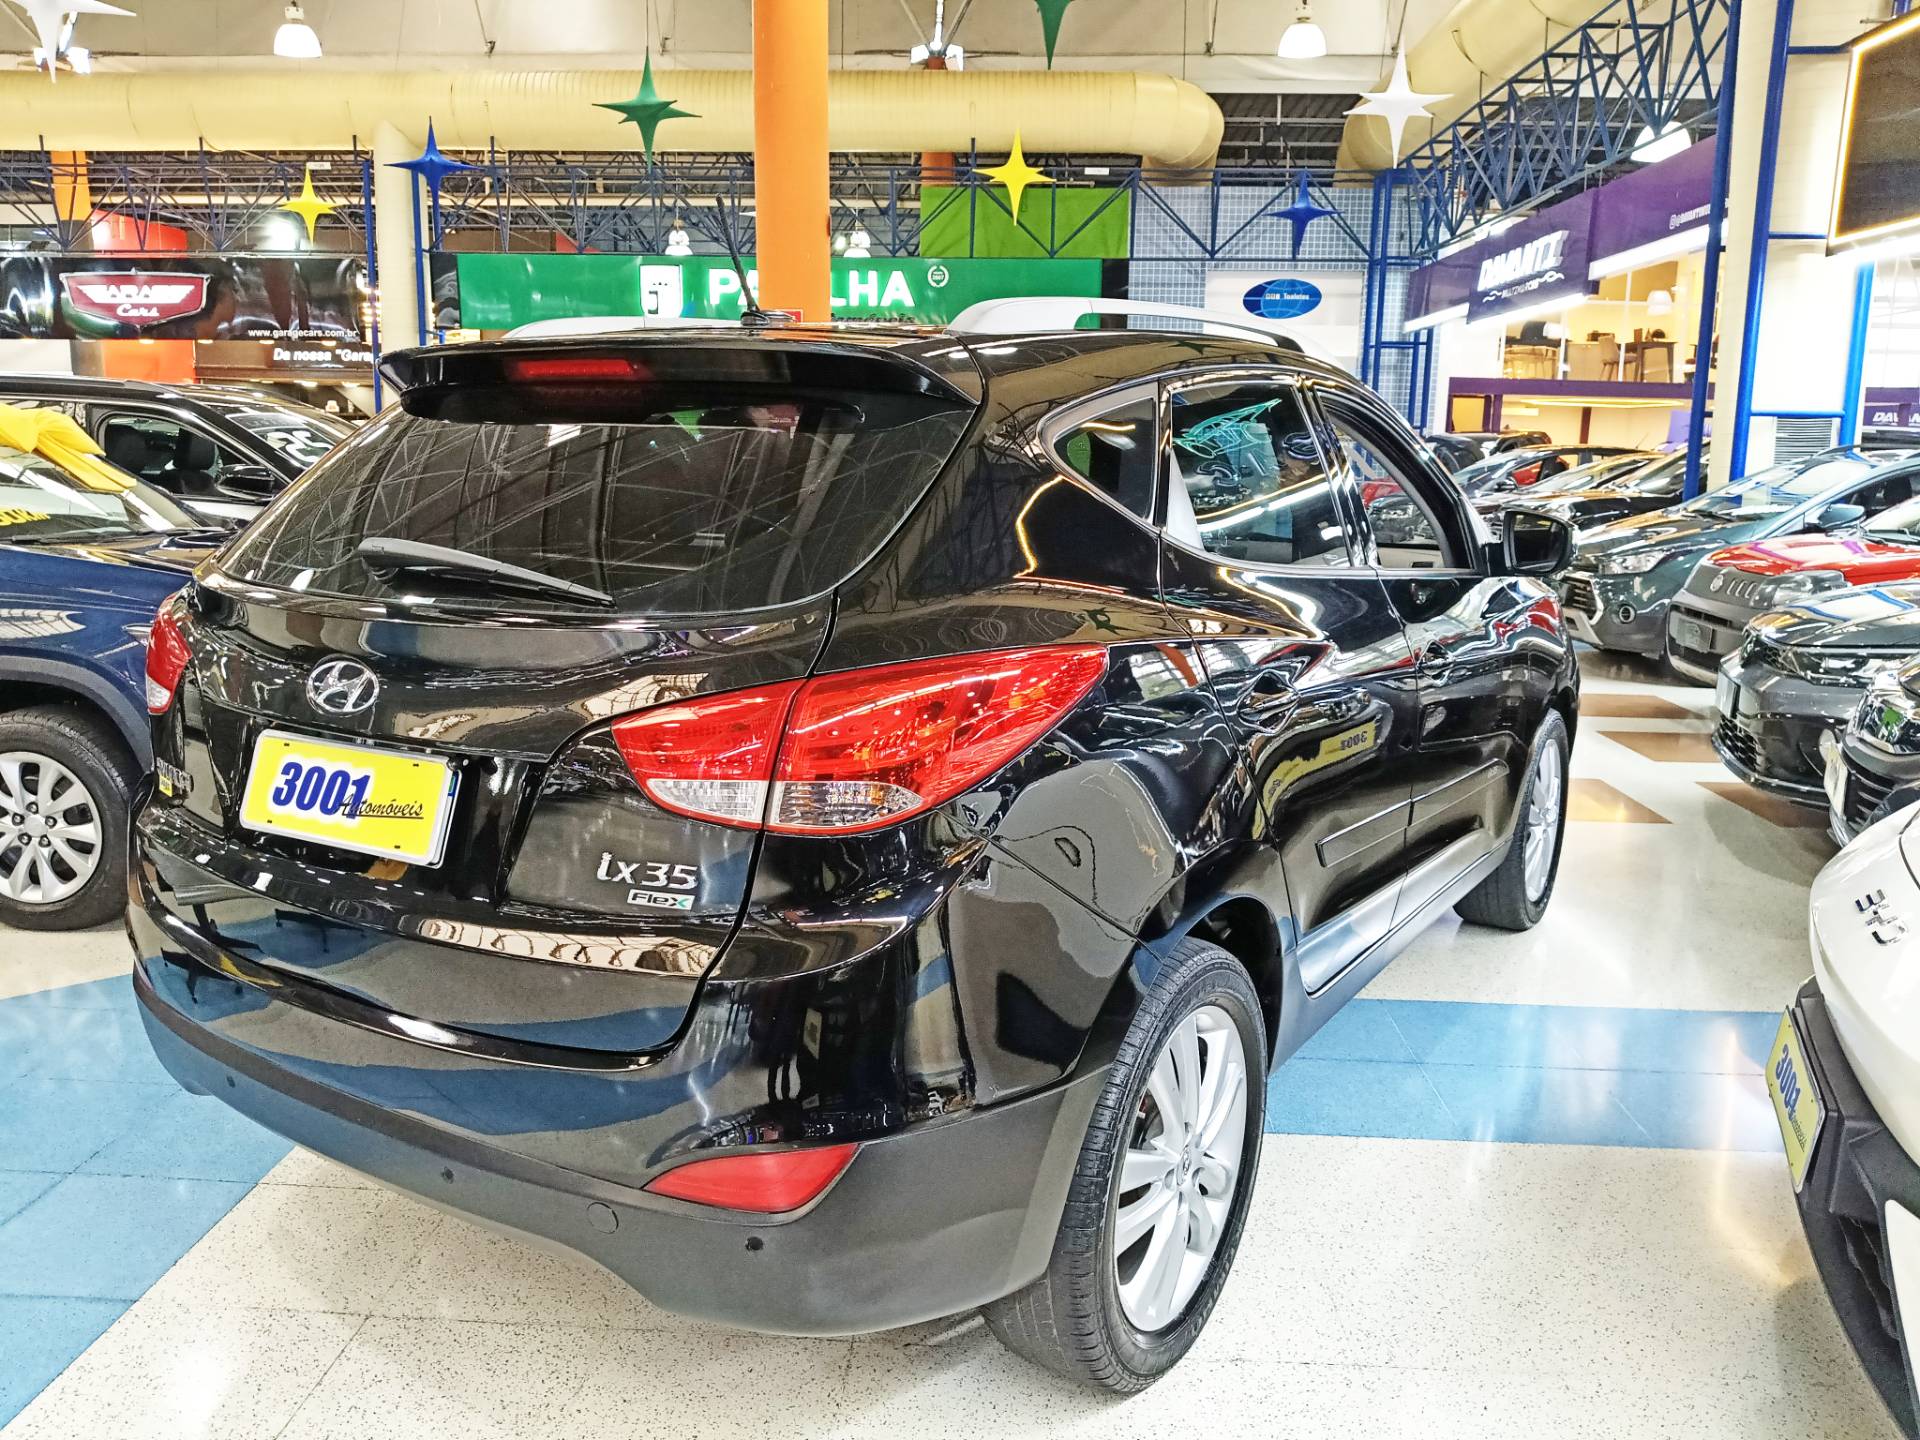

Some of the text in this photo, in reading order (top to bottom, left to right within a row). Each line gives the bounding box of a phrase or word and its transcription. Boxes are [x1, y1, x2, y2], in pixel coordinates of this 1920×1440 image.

[116, 303, 160, 317] Cars
[272, 761, 370, 819] 3001
[338, 793, 424, 820] Automóveis
[597, 851, 698, 890] ix35
[631, 892, 689, 909] Flex
